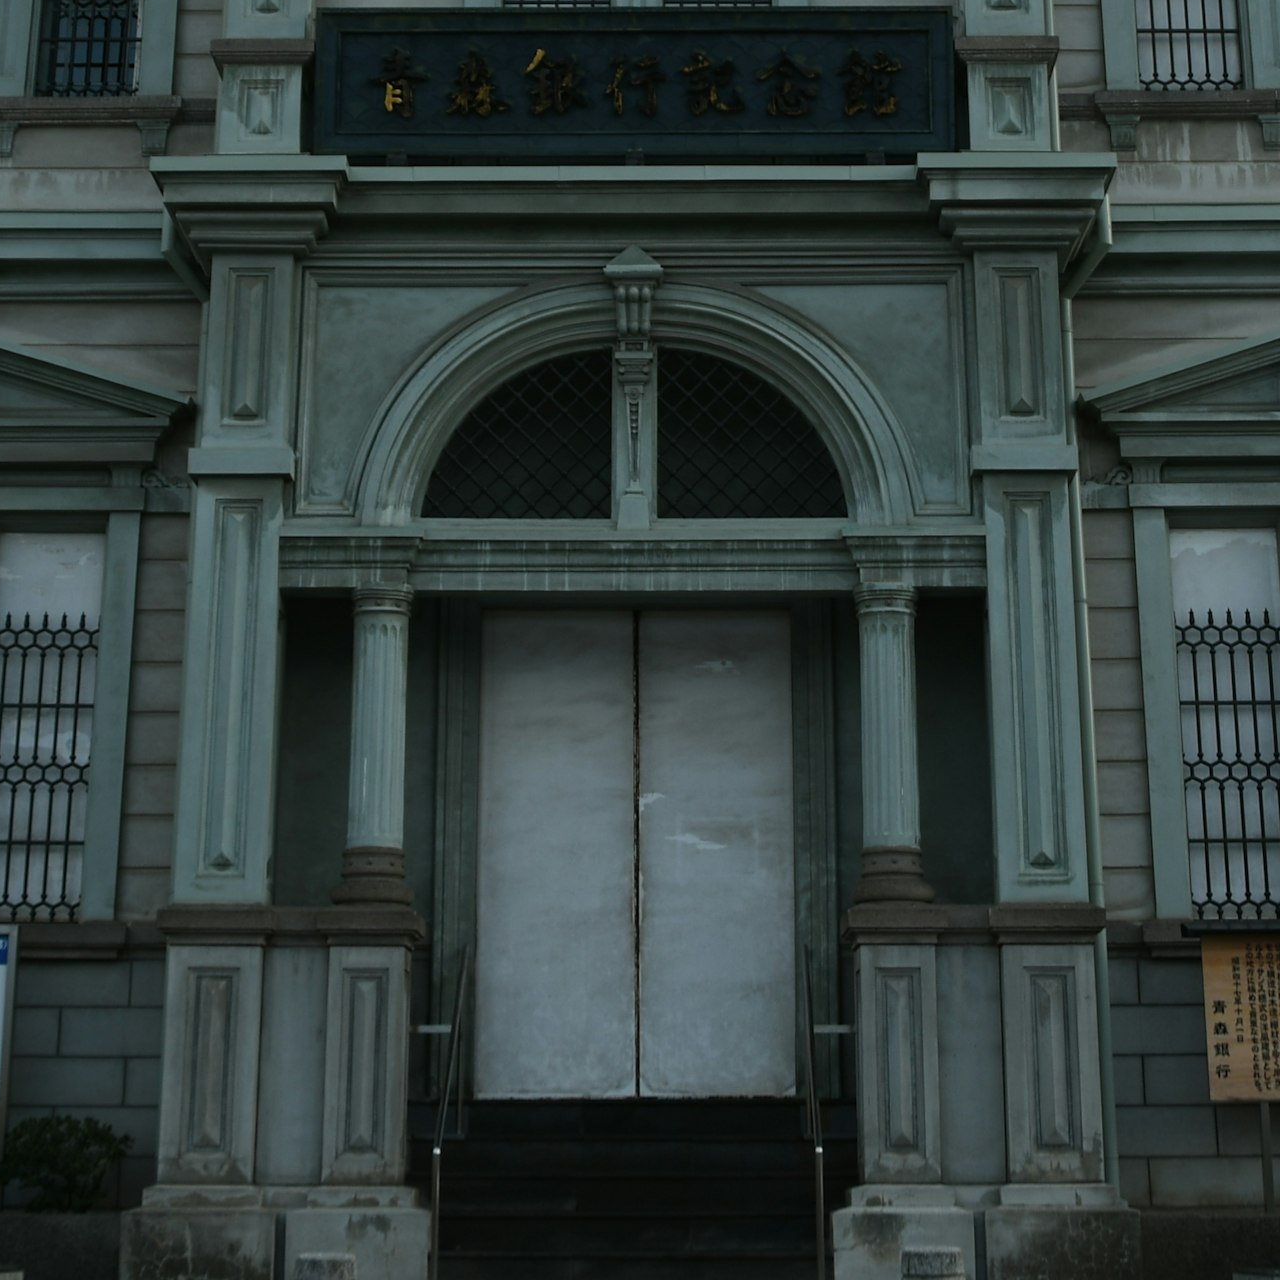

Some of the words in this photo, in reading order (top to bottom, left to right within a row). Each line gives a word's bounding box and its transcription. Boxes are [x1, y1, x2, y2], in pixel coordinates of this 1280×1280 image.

[369, 46, 905, 119] 青森銀行記念館
[1211, 1000, 1231, 1079] 青森銀行
